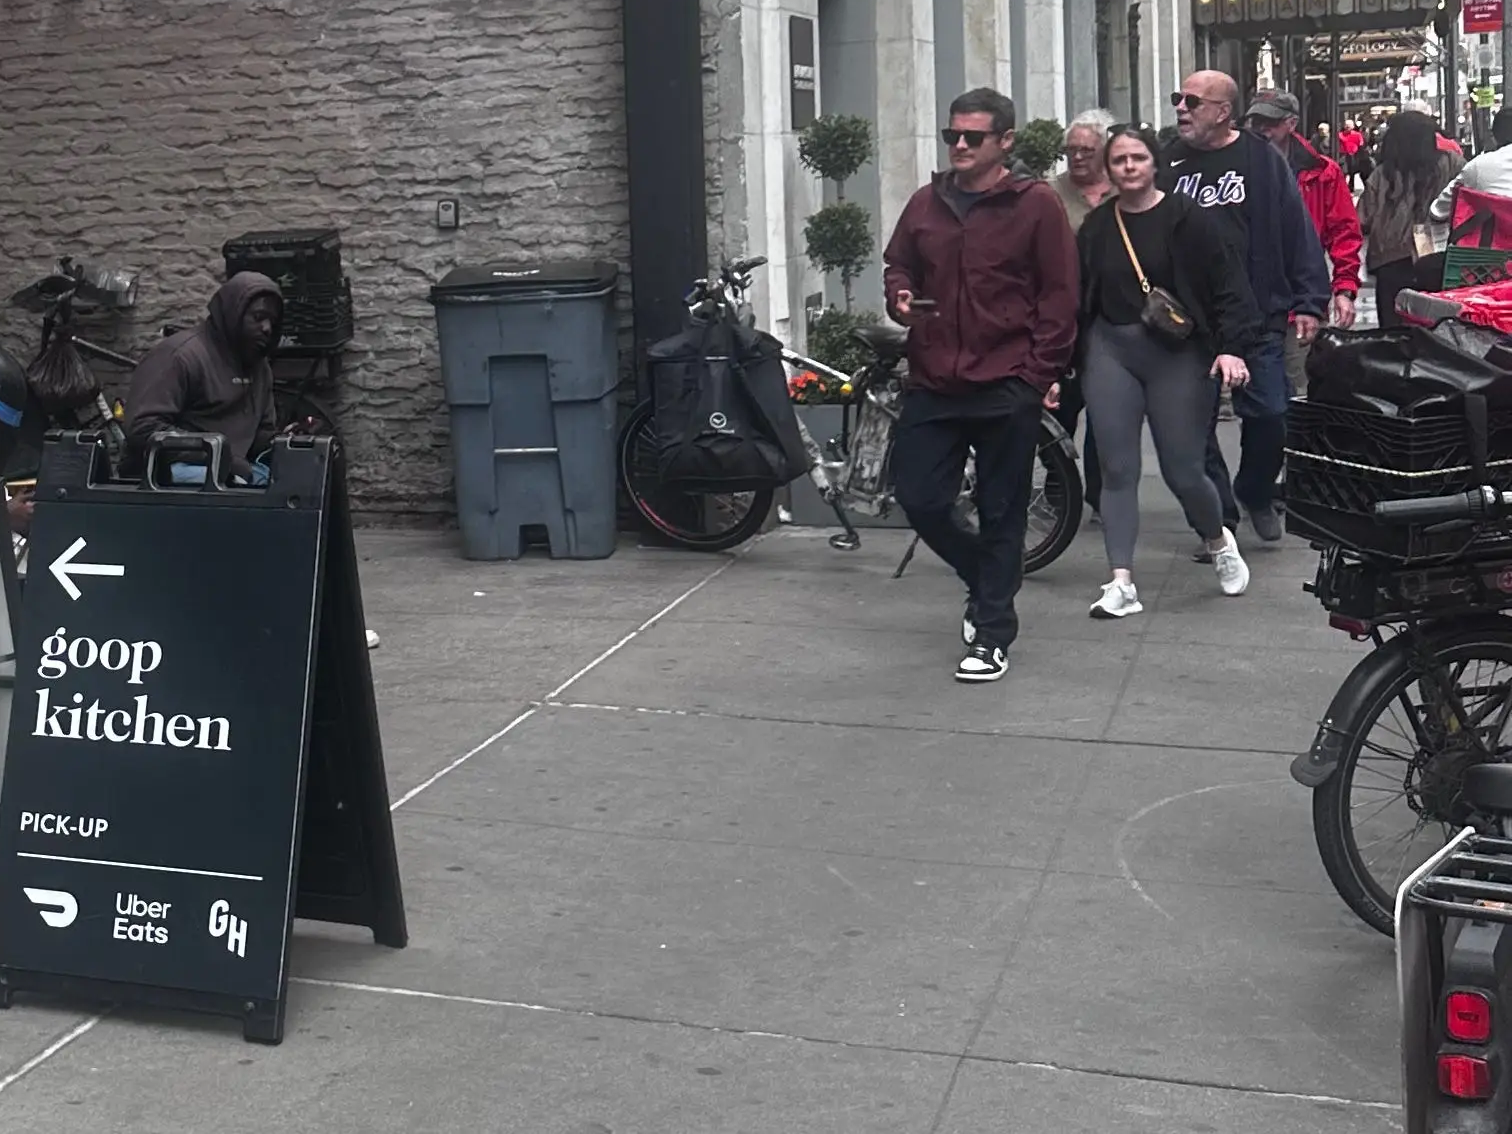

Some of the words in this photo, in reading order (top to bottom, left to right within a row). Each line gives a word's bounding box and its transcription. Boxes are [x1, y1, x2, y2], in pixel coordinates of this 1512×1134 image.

[1173, 171, 1245, 207] Mets
[37, 627, 162, 684] goop
[31, 689, 232, 752] kitchen
[20, 812, 109, 839] PICK-UP
[115, 893, 172, 920] Uber
[113, 918, 169, 945] Eats
[207, 898, 248, 958] GH
